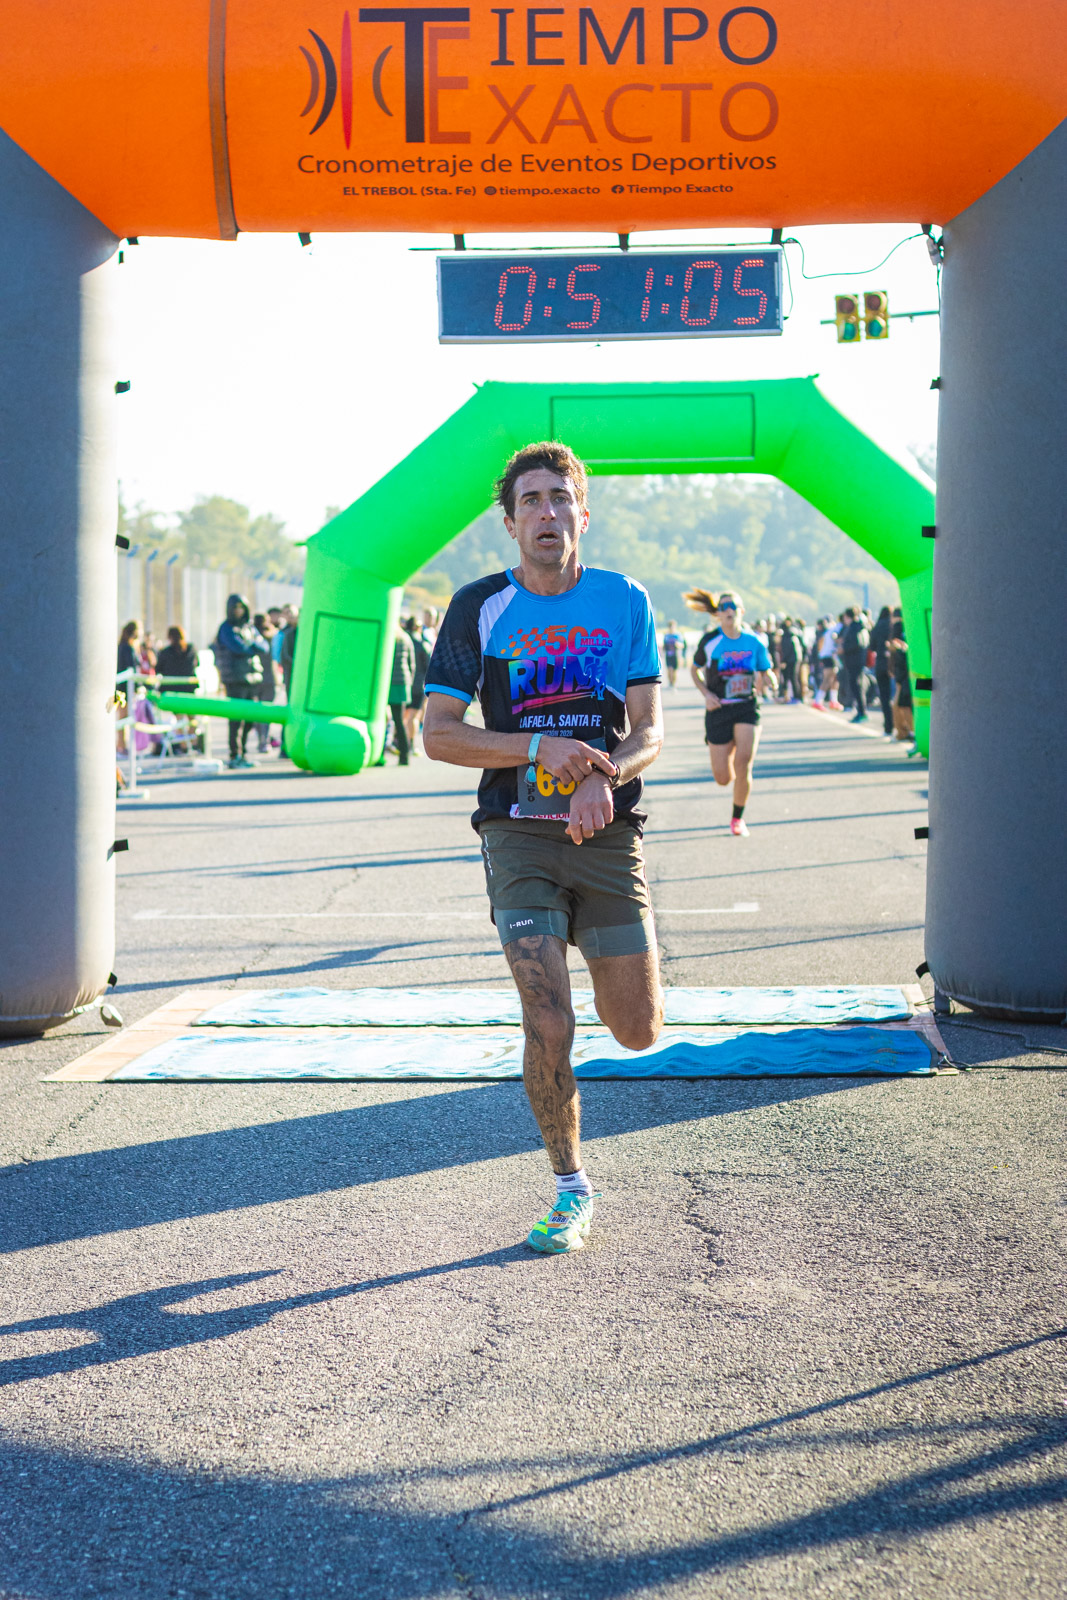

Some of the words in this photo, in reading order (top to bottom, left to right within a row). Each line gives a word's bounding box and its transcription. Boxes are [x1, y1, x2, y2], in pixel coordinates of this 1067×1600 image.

[298, 154, 473, 178] Cronometraje
[480, 153, 512, 173] de
[521, 153, 623, 173] Eventos
[632, 152, 777, 175] Deportivos
[343, 186, 359, 196] EL
[361, 186, 417, 196] TREBOL
[421, 186, 452, 197] (Sta.
[455, 186, 476, 197] Fe)
[500, 185, 601, 197] tiempo.exacto
[627, 184, 682, 195] Tiempo
[686, 184, 734, 194] Exacto
[580, 637, 613, 648] MILLAS
[558, 714, 589, 728] SANTA
[591, 714, 602, 727] FE
